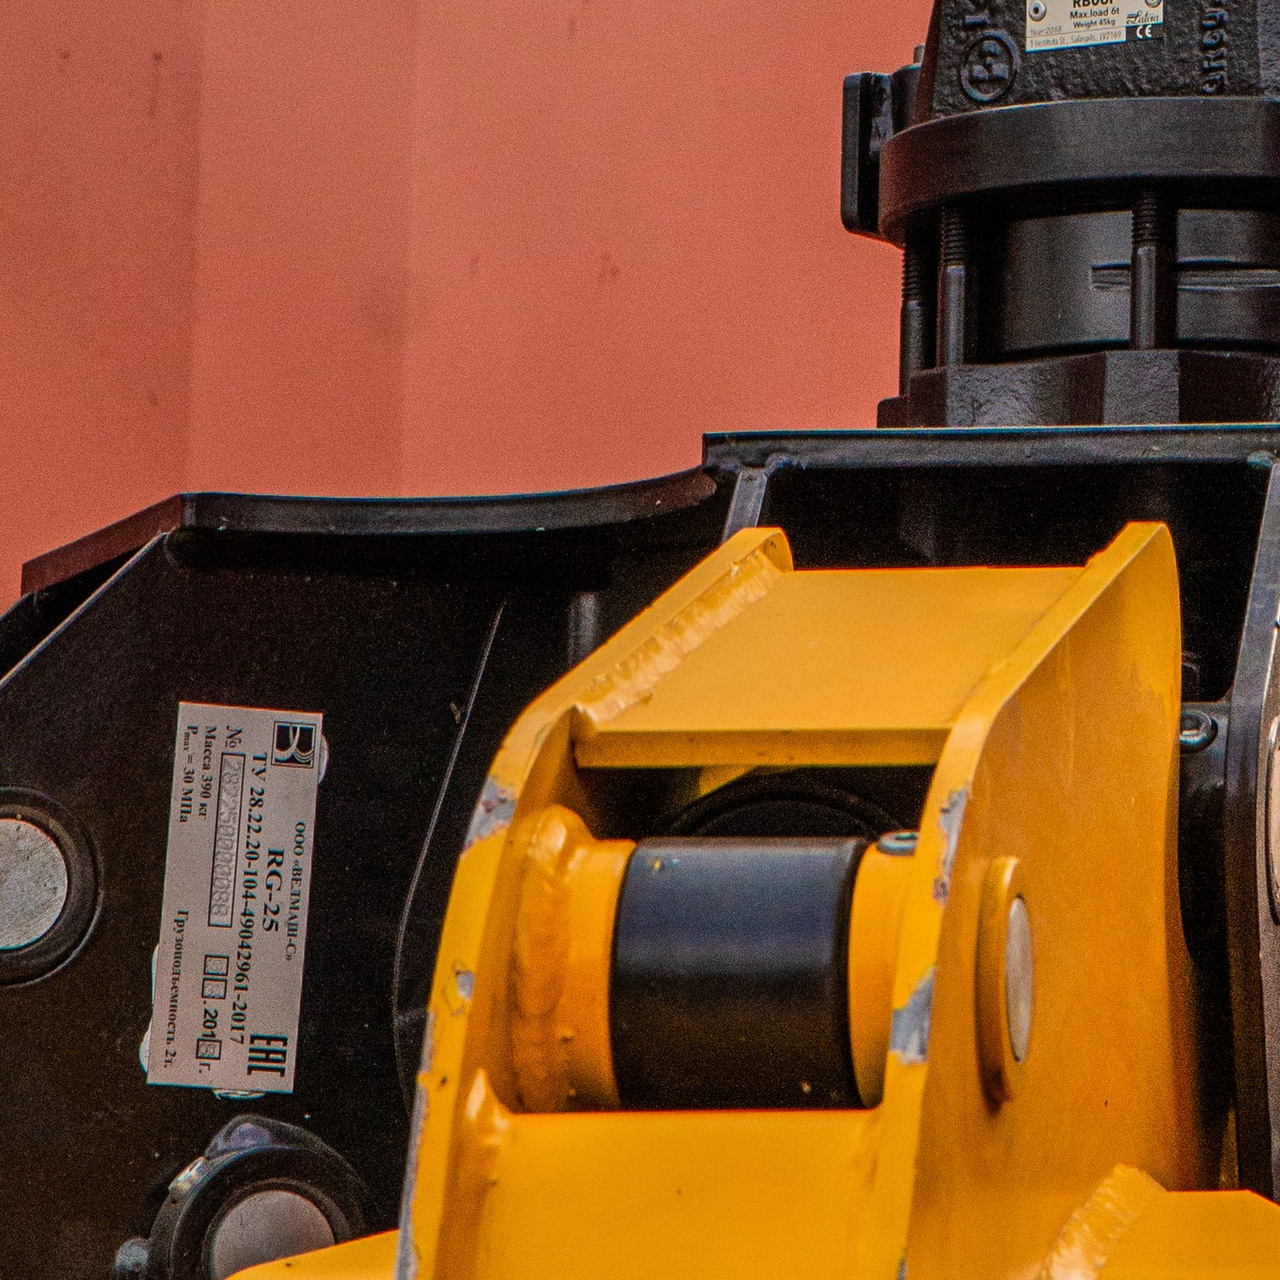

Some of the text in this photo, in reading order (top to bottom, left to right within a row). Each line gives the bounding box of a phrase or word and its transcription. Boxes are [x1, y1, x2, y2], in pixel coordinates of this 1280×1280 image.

[1073, 18, 1116, 30] Weight 45kg
[1110, 7, 1120, 15] 6t
[179, 788, 194, 823] МПа
[183, 767, 195, 784] 30
[198, 726, 217, 820] Масса 390 кг
[230, 752, 267, 1045] ТУ 28.22.20-104-49042961-2017
[262, 848, 285, 932] RG-25
[285, 821, 306, 961] ООО «ВЕЛМАШ-С»
[166, 910, 189, 1045] Грузоподъемность
